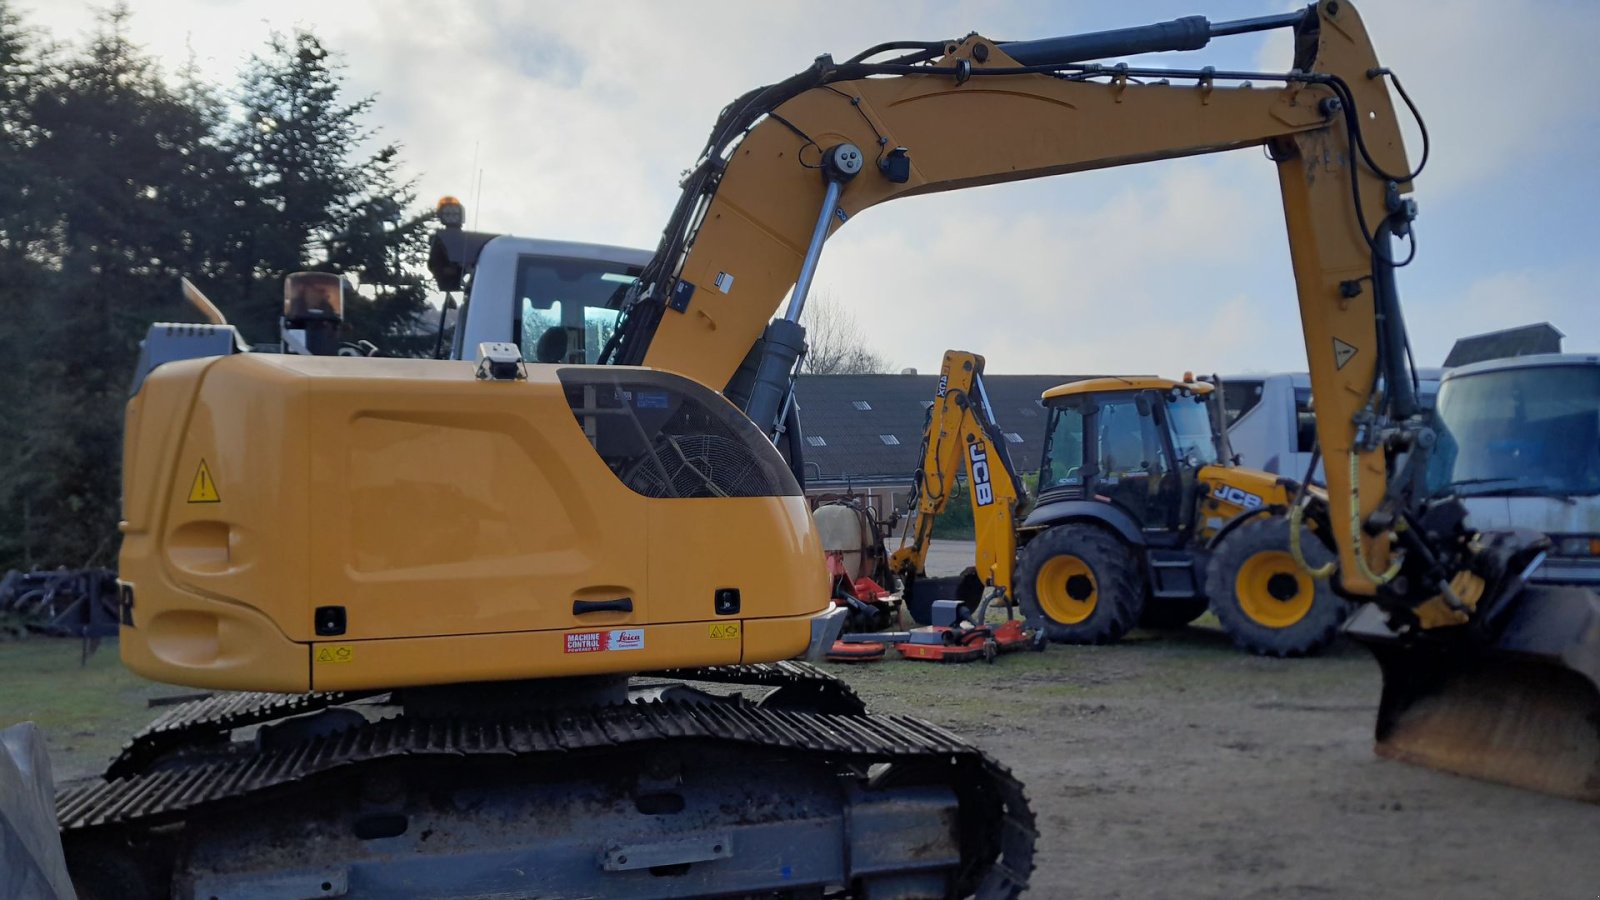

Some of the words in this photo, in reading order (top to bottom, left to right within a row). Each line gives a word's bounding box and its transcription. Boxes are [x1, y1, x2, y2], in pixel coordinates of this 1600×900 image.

[970, 444, 992, 506] JCB
[1214, 486, 1262, 509] JCB
[567, 633, 600, 642] MACHINE
[616, 631, 641, 643] Leica
[567, 640, 600, 648] CONTROL
